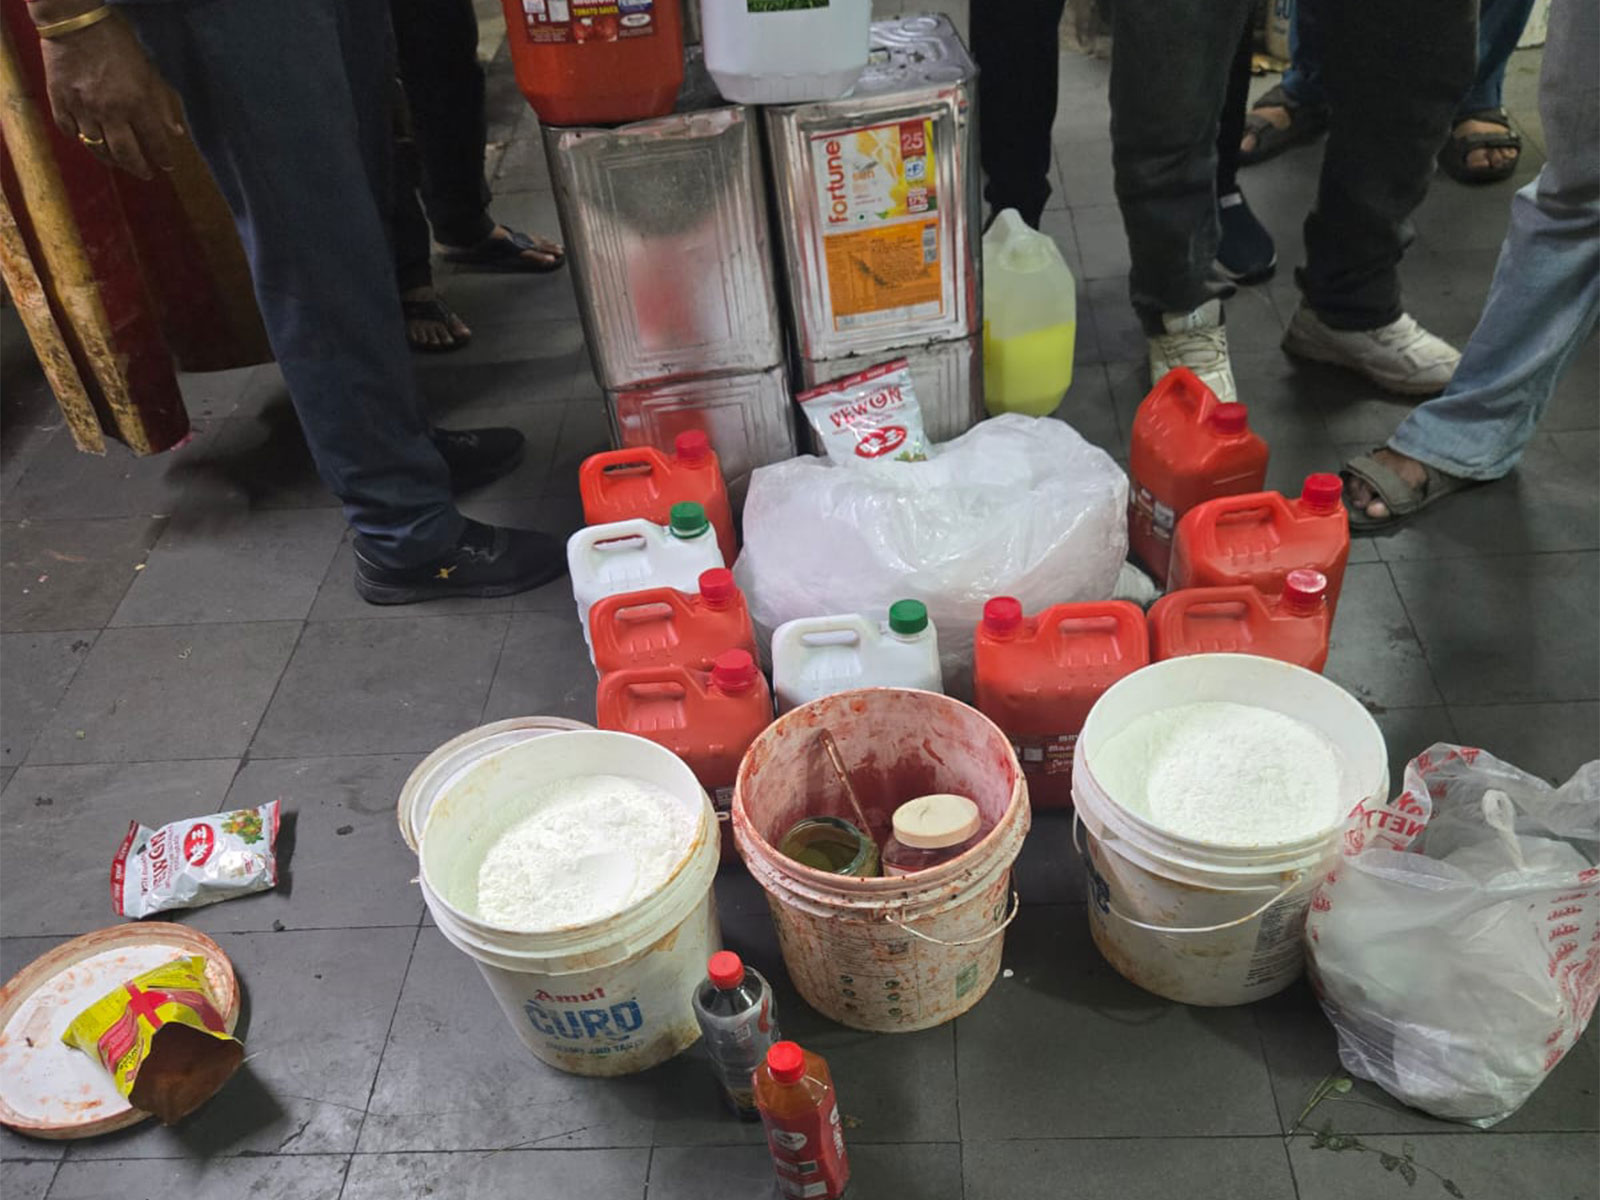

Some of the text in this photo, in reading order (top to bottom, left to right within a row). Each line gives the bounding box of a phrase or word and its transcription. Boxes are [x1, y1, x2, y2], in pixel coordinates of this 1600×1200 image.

[826, 140, 849, 224] fortune
[535, 987, 605, 1003] Amul
[523, 1000, 643, 1040] CURD
